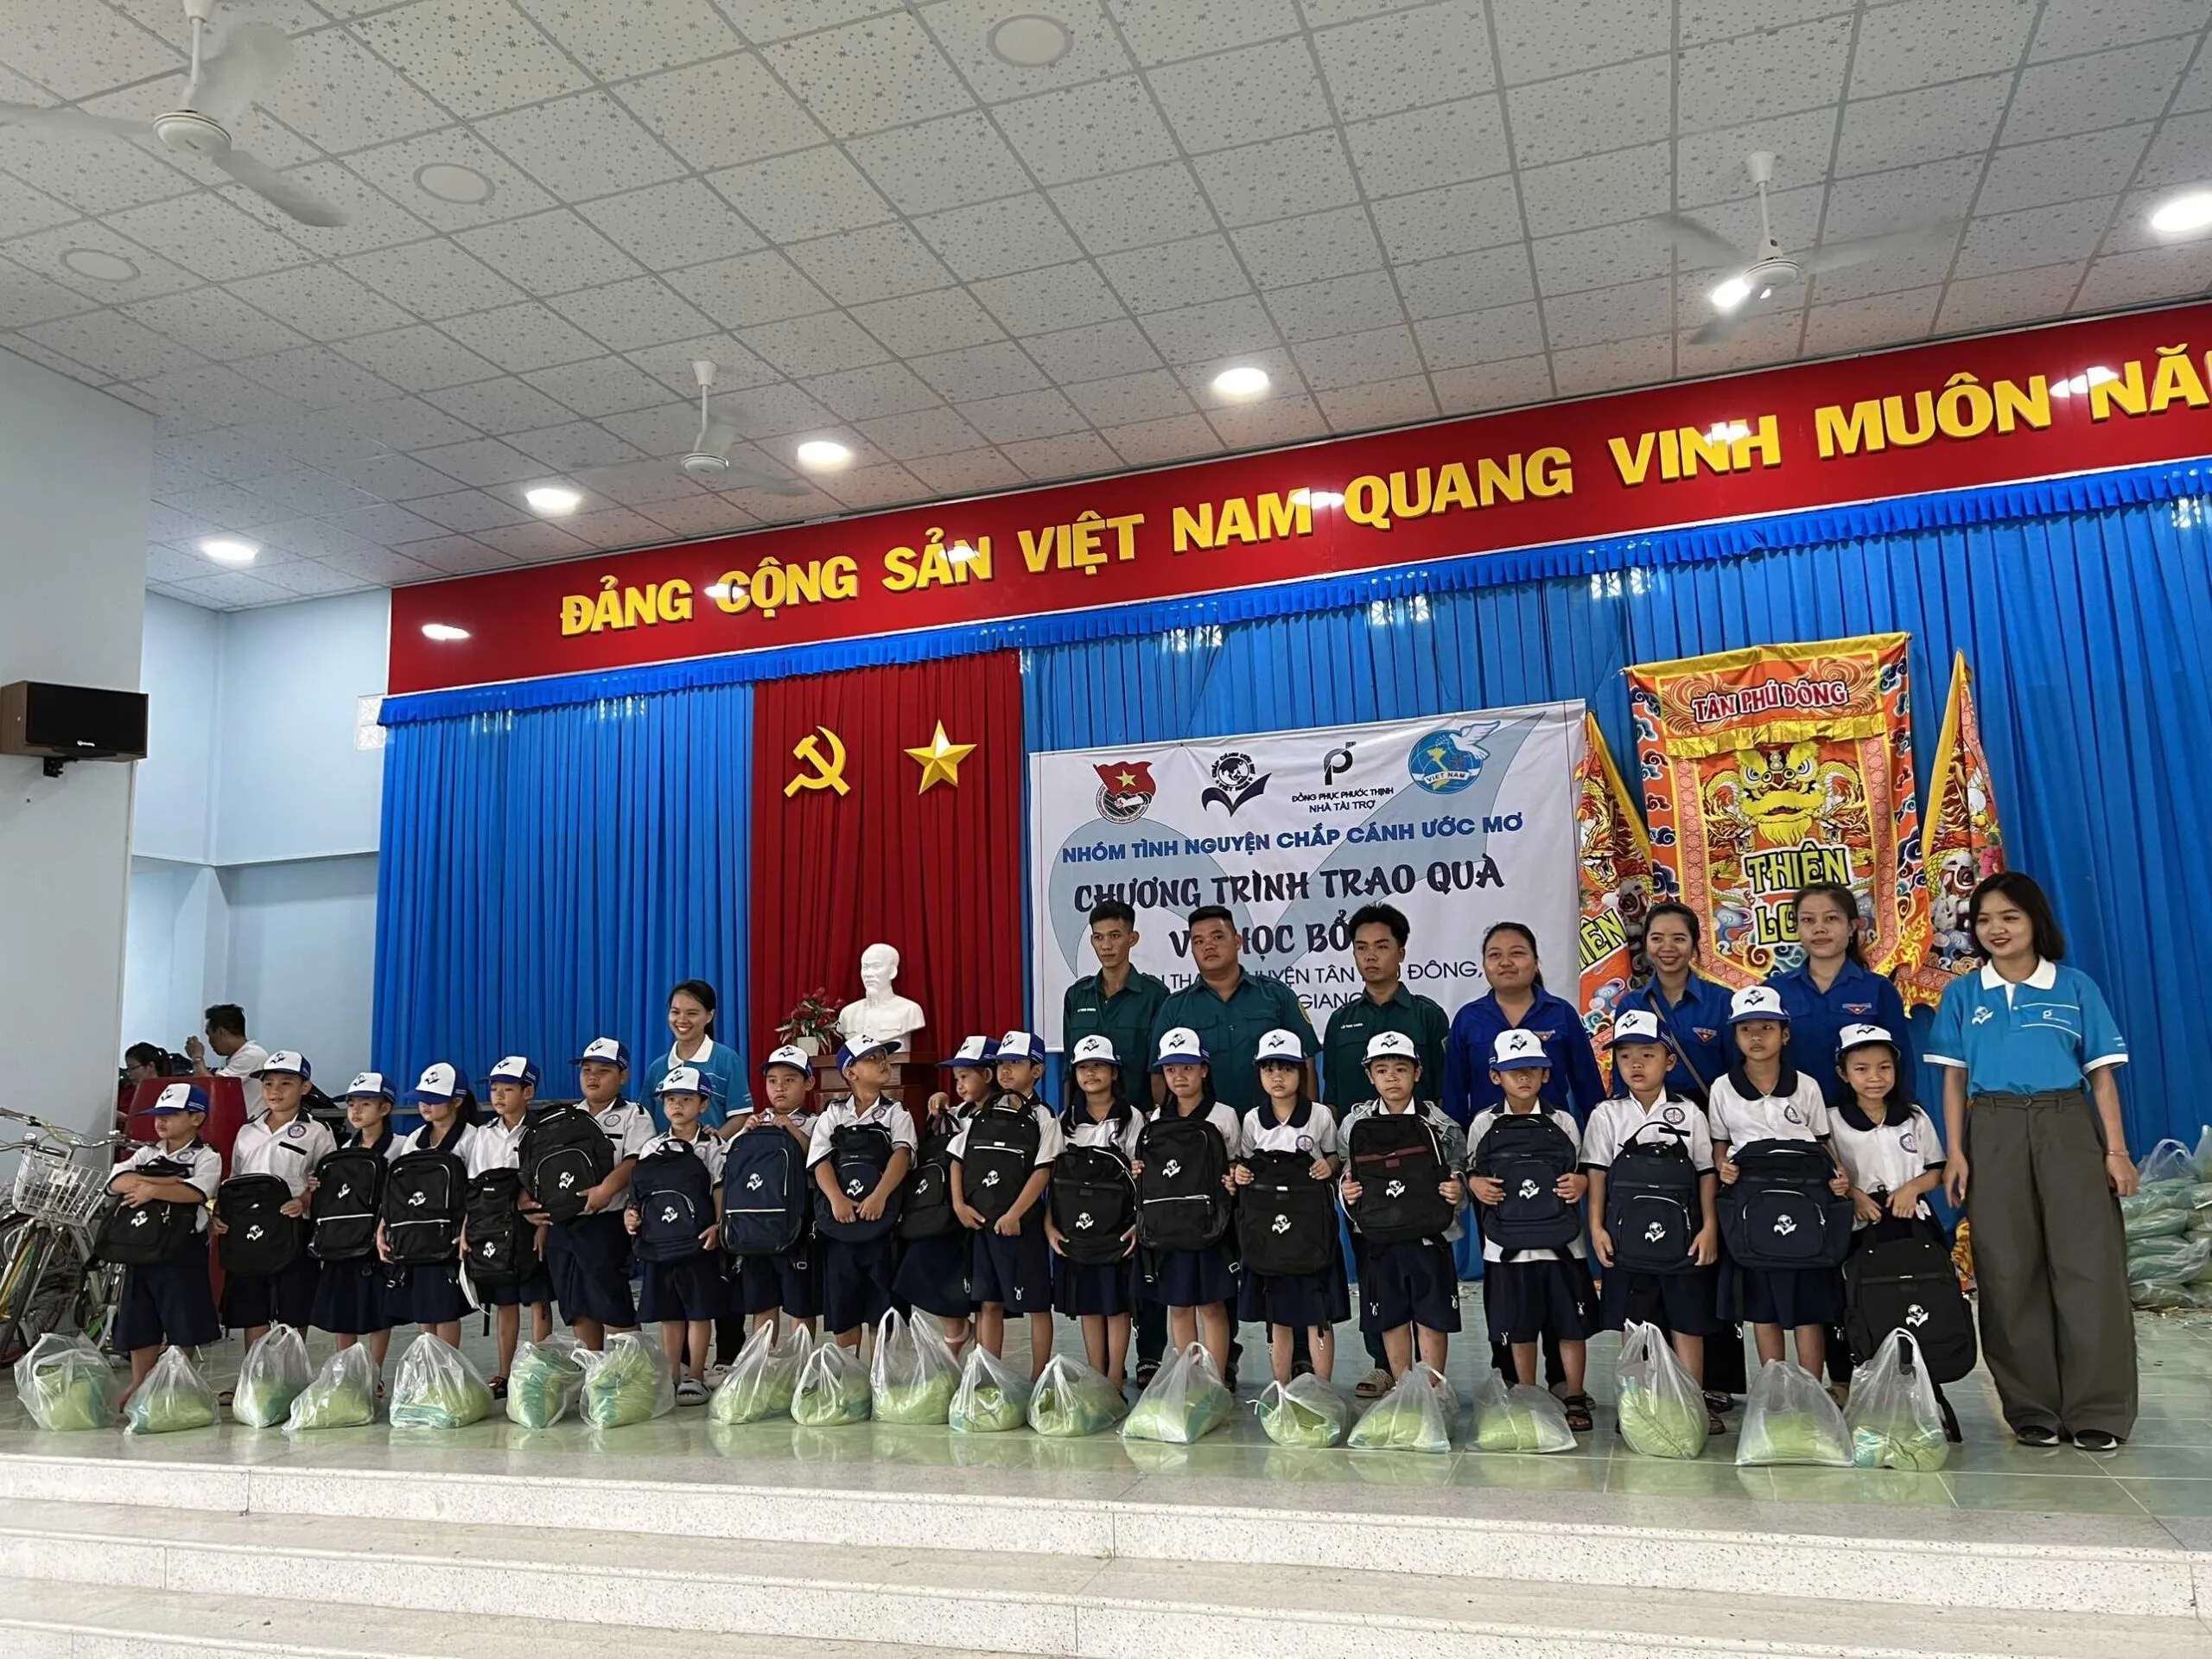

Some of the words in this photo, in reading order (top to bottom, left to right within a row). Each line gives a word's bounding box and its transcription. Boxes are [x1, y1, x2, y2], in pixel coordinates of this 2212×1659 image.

[561, 575, 692, 635] ĐẢNG
[715, 556, 857, 618] CỘNG
[882, 527, 992, 591] SẢN
[1019, 511, 1144, 575] VIỆT
[1173, 489, 1313, 552] NAM
[1344, 448, 1573, 529] QUANG
[1609, 415, 1782, 485] VINH
[1815, 372, 2051, 458] MUÔN
[2088, 344, 2212, 420] NĂ
[1693, 693, 1737, 722] TÂN
[1740, 680, 1779, 713] PHÚ
[1783, 681, 1847, 708] ĐÔNG
[1309, 803, 1332, 813] NHÀ
[1333, 800, 1350, 811] TÀI
[1352, 799, 1376, 811] TRỢ
[1319, 791, 1339, 802] PHỤC
[1370, 786, 1395, 798] THỊNH
[1063, 842, 1126, 863] NHÓM
[1132, 839, 1179, 858] TÌNH
[1185, 831, 1270, 855] NGUYỆN
[1277, 823, 1340, 848] CHẮP
[1346, 822, 1414, 843] CÁNH
[1422, 816, 1475, 837] ƯỚC
[1483, 812, 1522, 833] MƠ
[1074, 876, 1201, 912] CHƯƠNG
[1211, 869, 1310, 906] TRÌNH
[1319, 864, 1416, 899] TRAO
[1427, 853, 1505, 895] QUÀ
[1745, 841, 1851, 893] THIÊN
[1169, 930, 1190, 958] V
[1580, 908, 1627, 971] IÊN
[1315, 964, 1355, 983] TÂN
[1408, 960, 1484, 980] ĐÔNG,
